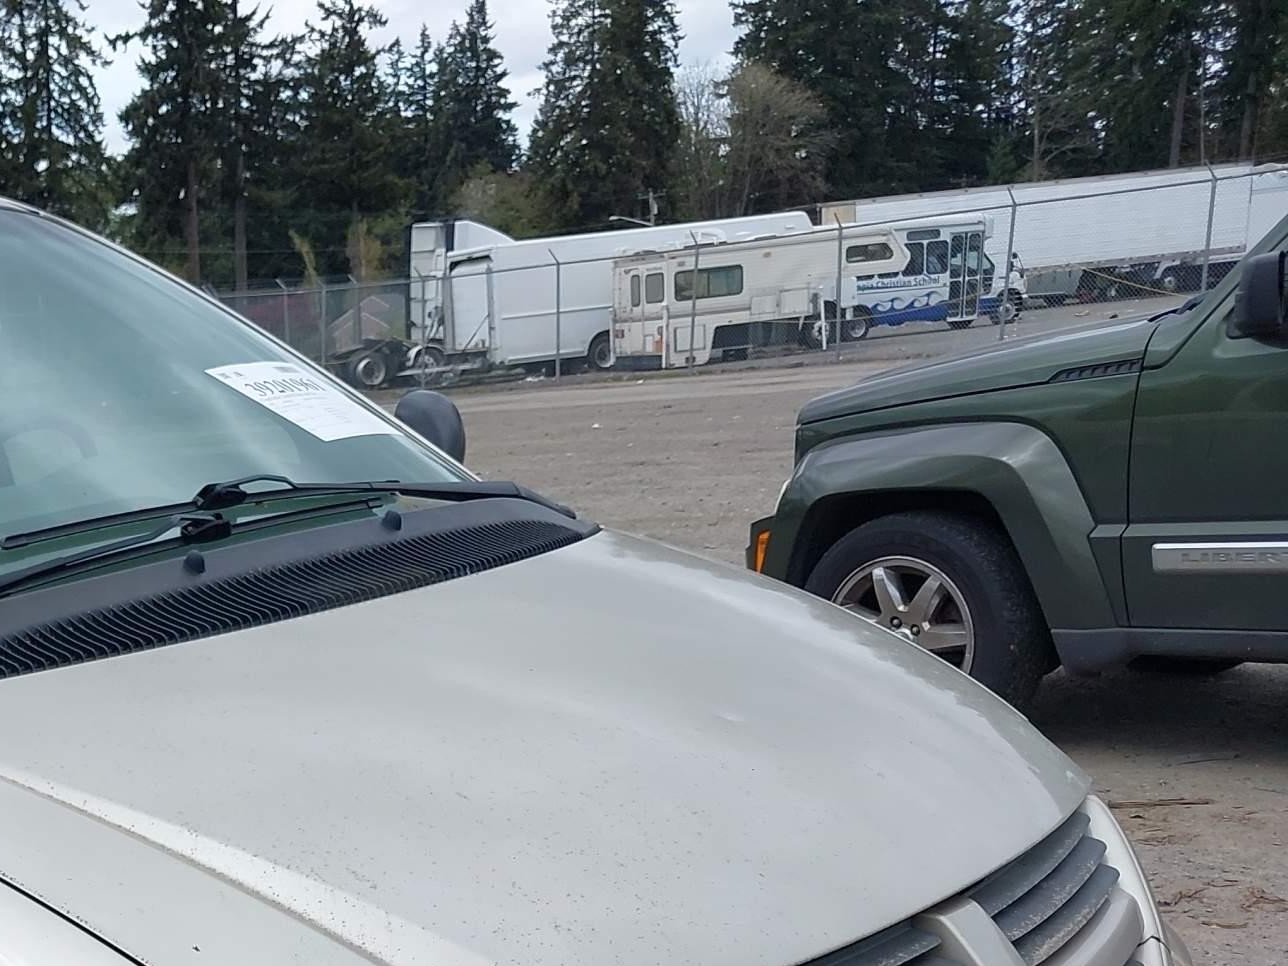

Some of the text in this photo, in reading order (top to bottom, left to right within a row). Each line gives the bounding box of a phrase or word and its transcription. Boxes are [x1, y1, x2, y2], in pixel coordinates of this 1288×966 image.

[876, 279, 912, 289] Christian
[913, 276, 940, 287] School
[244, 377, 326, 397] 39201961
